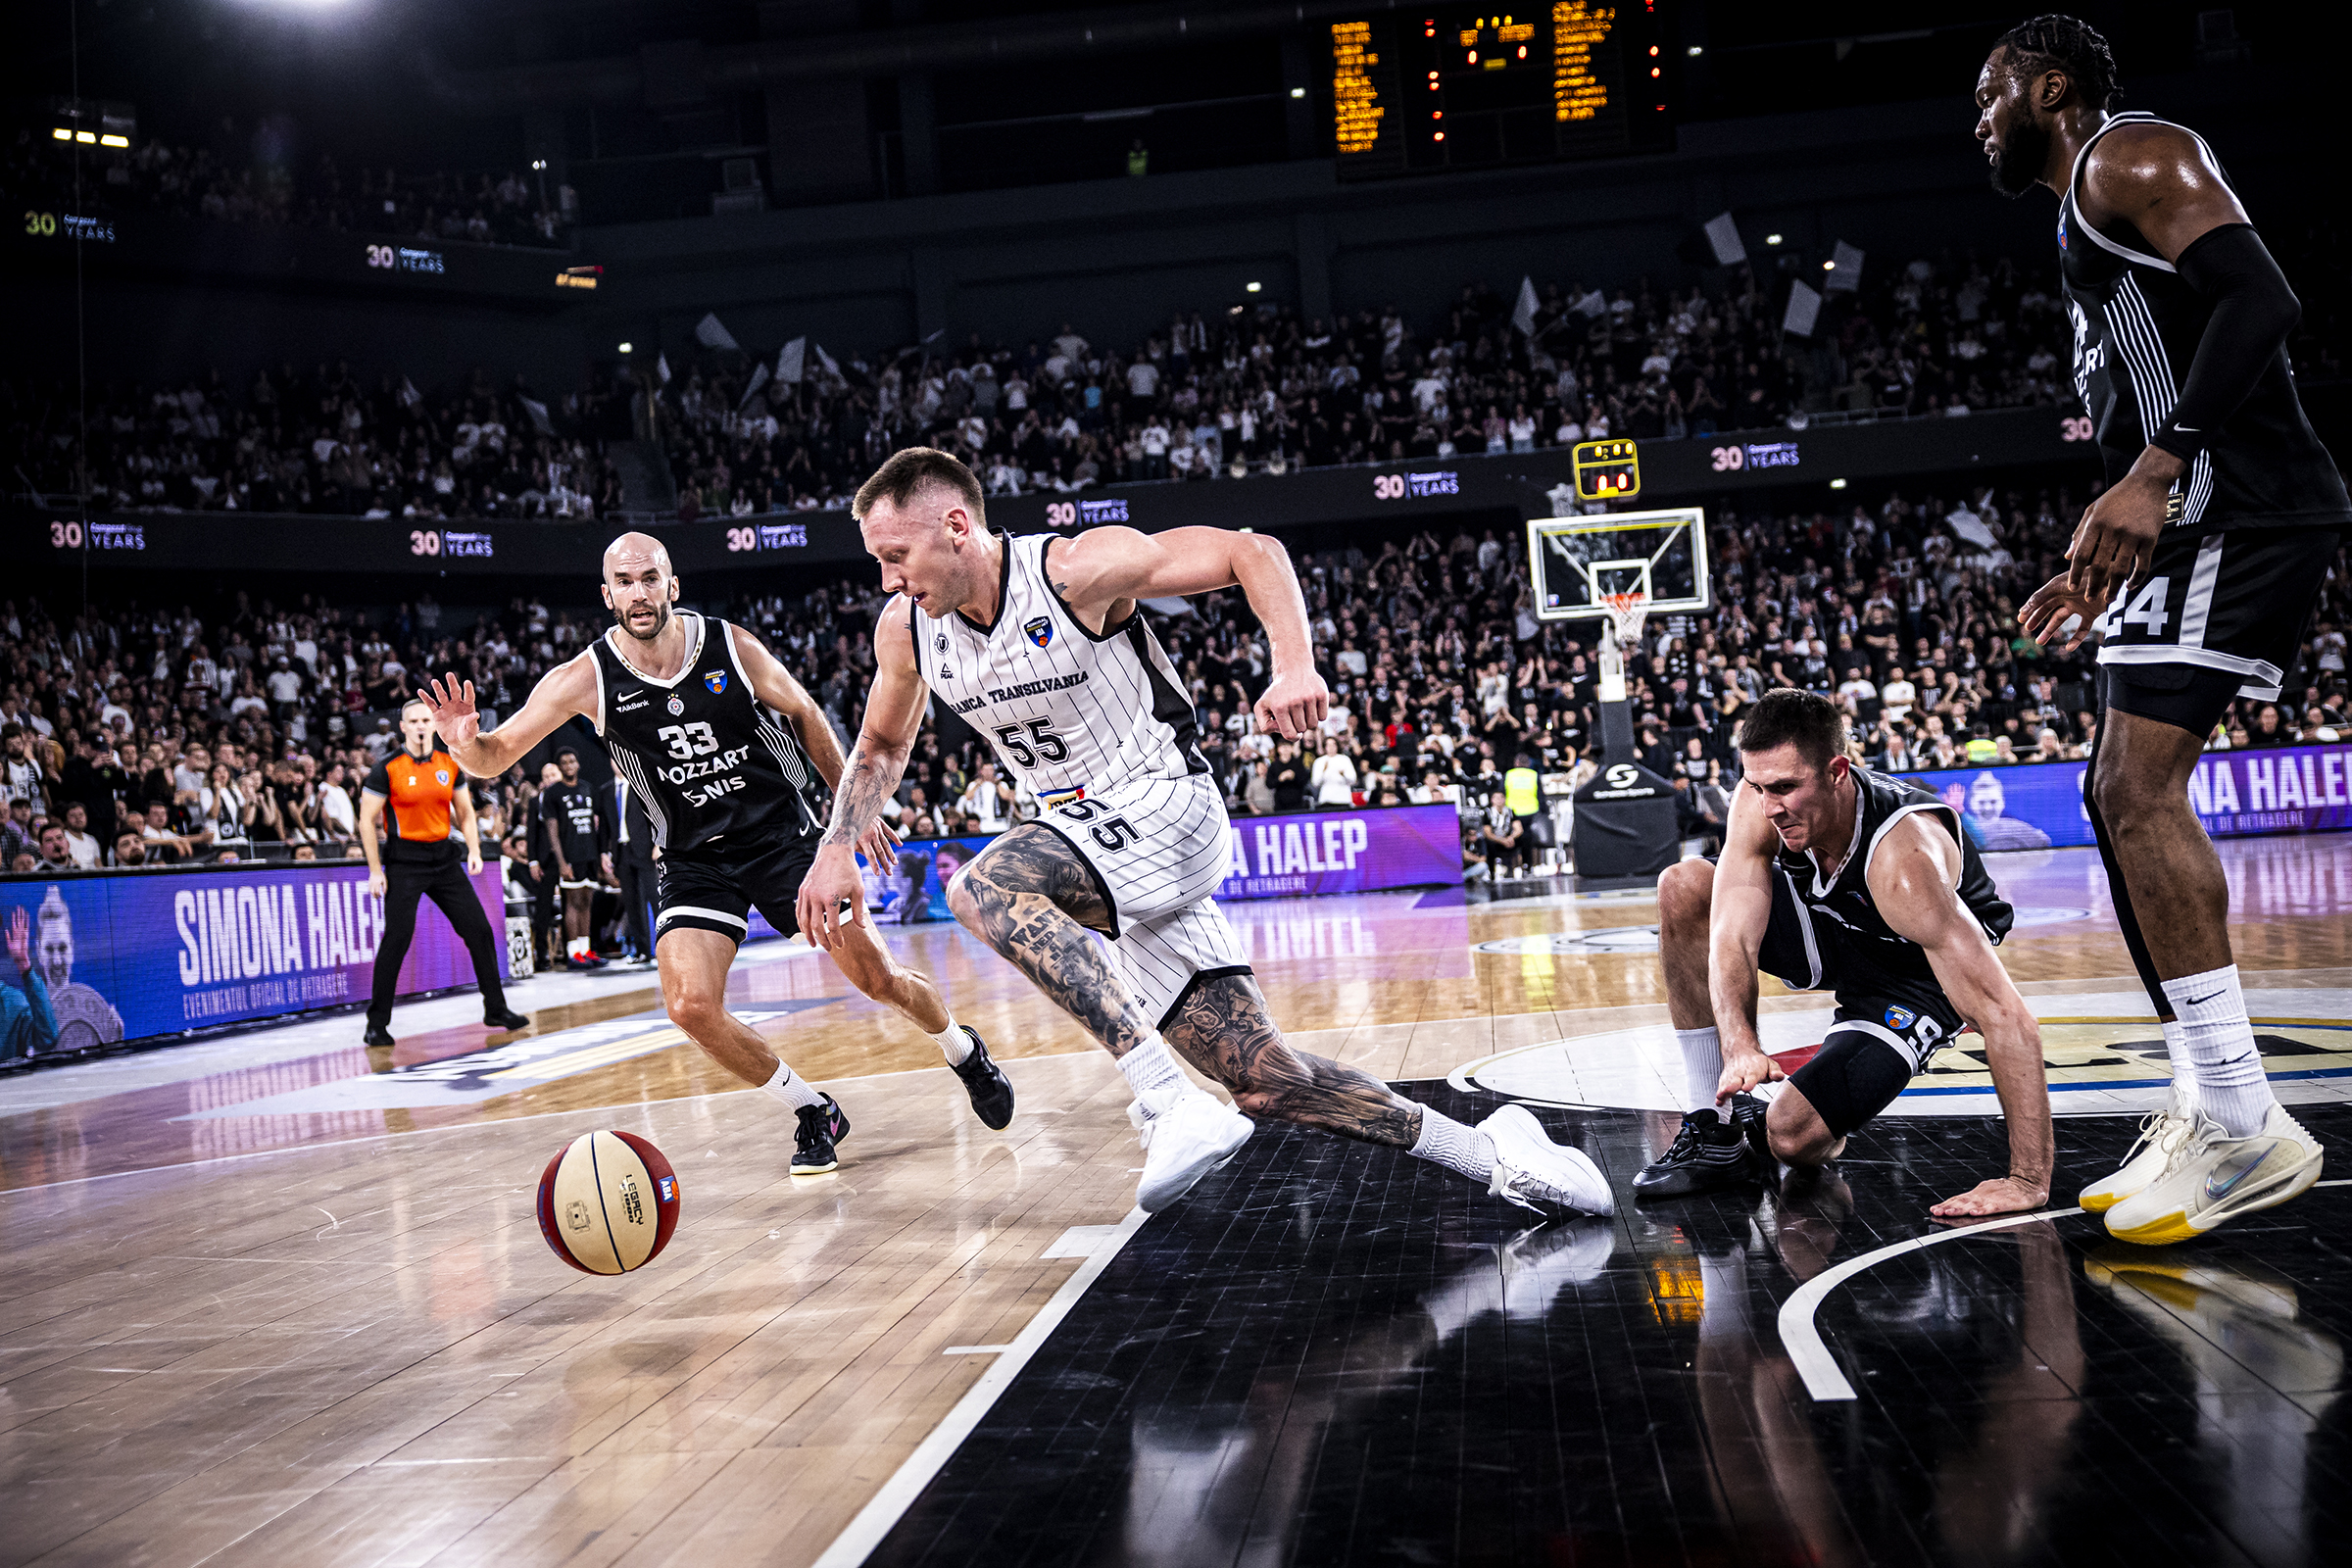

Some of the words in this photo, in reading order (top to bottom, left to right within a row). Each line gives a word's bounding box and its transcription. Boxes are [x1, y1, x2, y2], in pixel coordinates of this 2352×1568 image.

[24, 210, 56, 236] 30
[65, 224, 116, 243] YEARS
[367, 245, 393, 269] 30
[402, 258, 445, 273] YEARS
[2061, 416, 2093, 441] 30
[1711, 446, 1743, 472] 30
[1749, 451, 1800, 468] YEARS
[1374, 474, 1404, 499] 30
[1410, 479, 1459, 497] YEARS
[1046, 502, 1076, 527] 30
[1081, 507, 1130, 524] YEARS
[50, 520, 82, 549] 30
[91, 533, 146, 551] YEARS
[411, 530, 440, 556] 30
[726, 527, 756, 552] 30
[761, 532, 808, 549] YEARS
[447, 541, 494, 558] YEARS
[2104, 576, 2170, 639] 24
[987, 670, 1090, 704] TRANSILVANIA
[657, 721, 719, 760] 33
[991, 714, 1071, 770] 55
[2246, 750, 2352, 812] HALE
[1055, 798, 1145, 855] 55
[1254, 818, 1368, 875] HALEP
[174, 885, 304, 987] SIMONA
[625, 1174, 644, 1225] LEGACY
[661, 1179, 673, 1200] ABA
